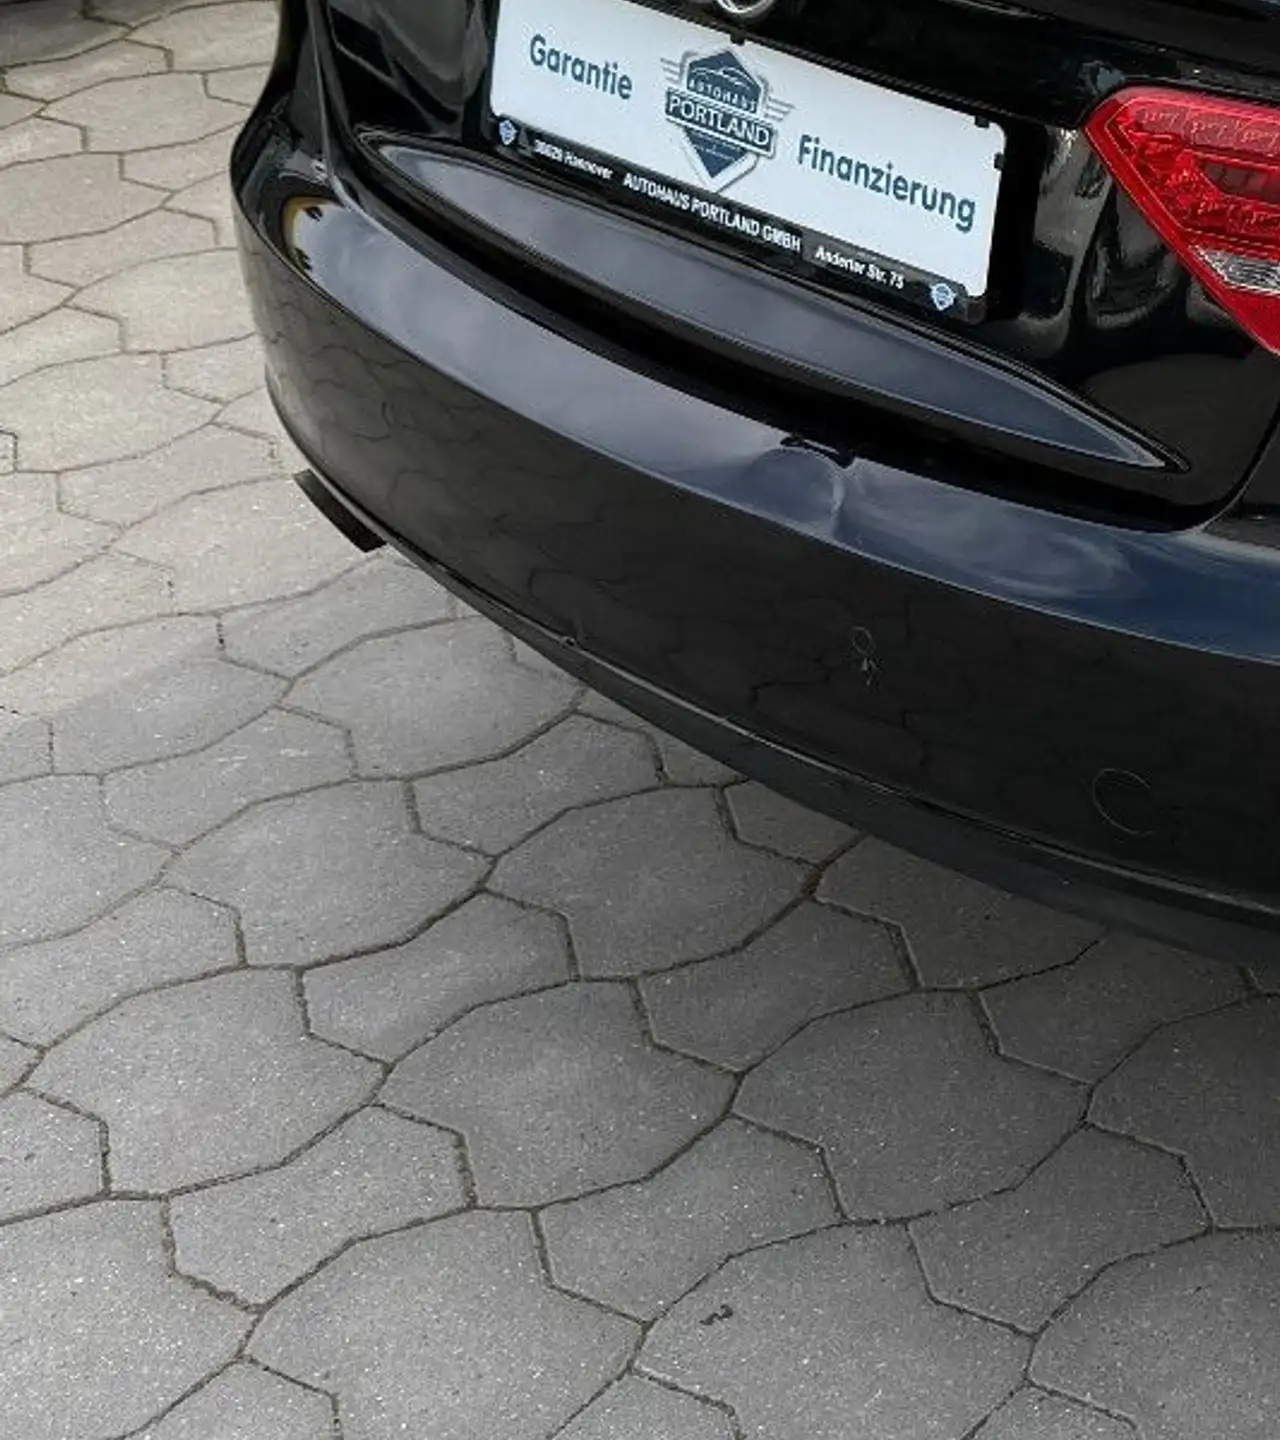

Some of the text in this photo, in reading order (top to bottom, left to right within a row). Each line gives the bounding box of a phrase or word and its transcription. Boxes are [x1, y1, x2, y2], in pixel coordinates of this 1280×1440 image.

[529, 33, 633, 101] Garantie
[667, 94, 771, 147] PORTLAND
[622, 171, 691, 212] AUTOHAUS
[690, 198, 761, 238] PORTLAND
[761, 224, 802, 253] GMBH
[797, 133, 977, 234] Finanzierung
